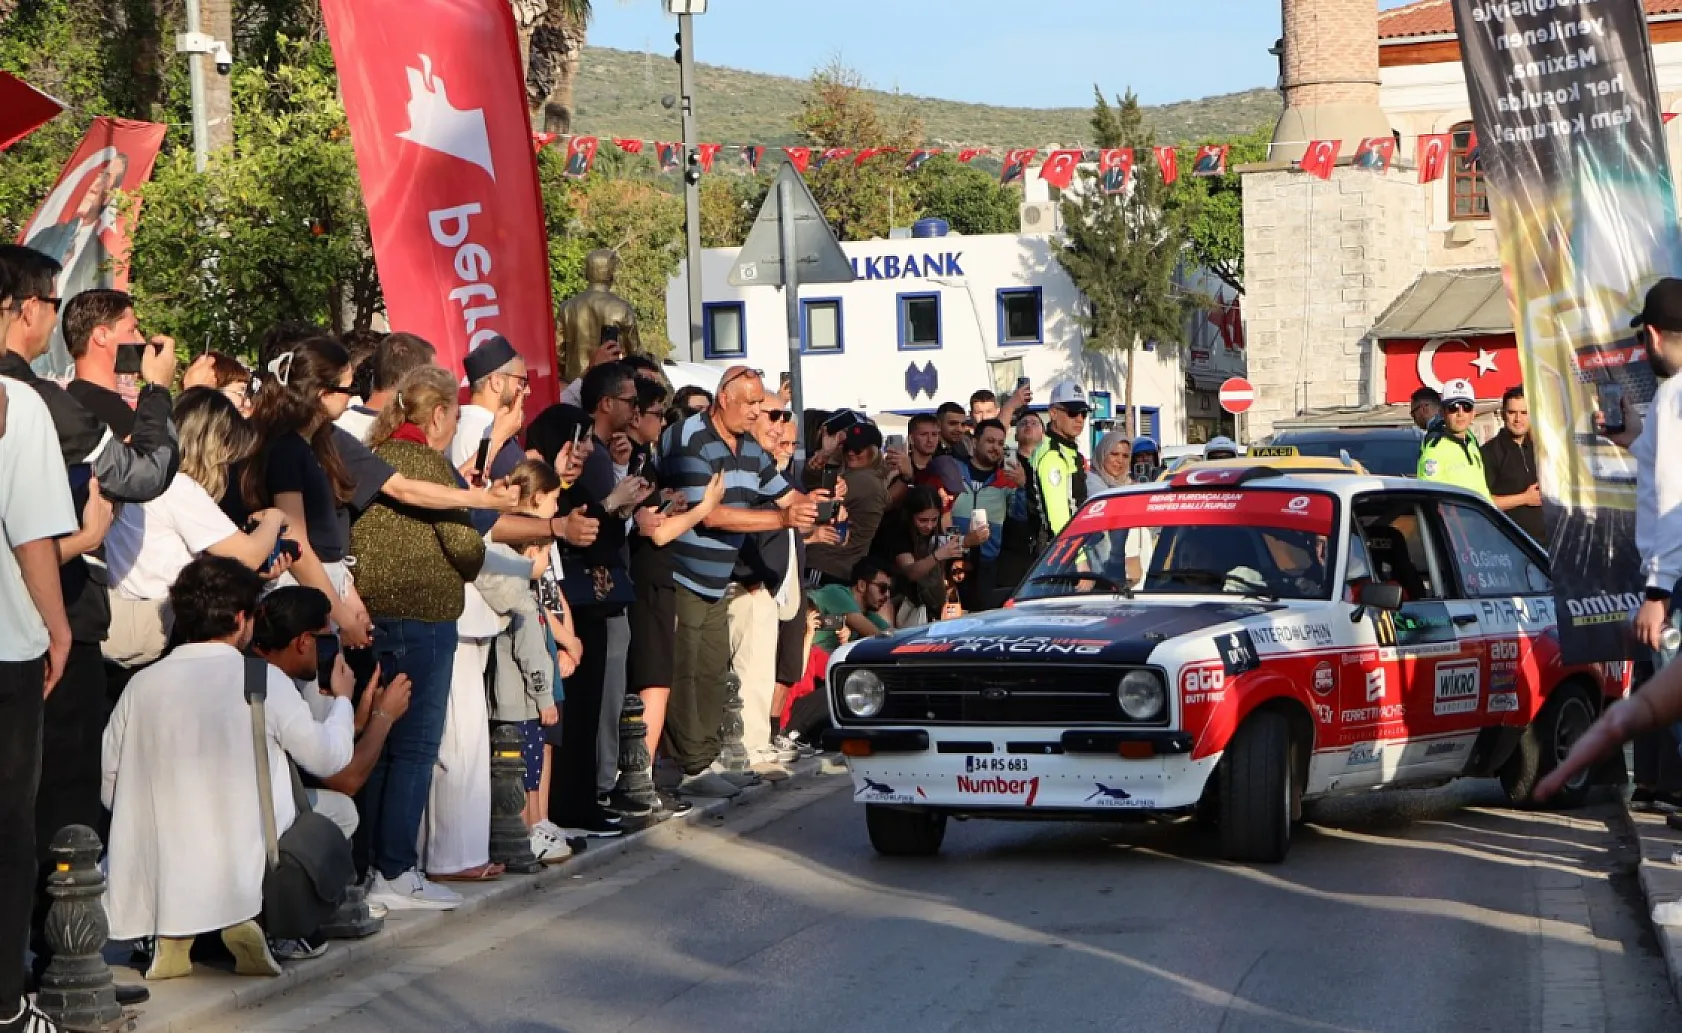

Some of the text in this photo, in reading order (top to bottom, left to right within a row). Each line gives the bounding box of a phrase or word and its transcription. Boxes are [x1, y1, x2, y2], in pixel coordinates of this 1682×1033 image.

[953, 642, 1105, 655] RACING
[1185, 667, 1225, 691] ato
[974, 759, 1028, 771] 34 RS 683
